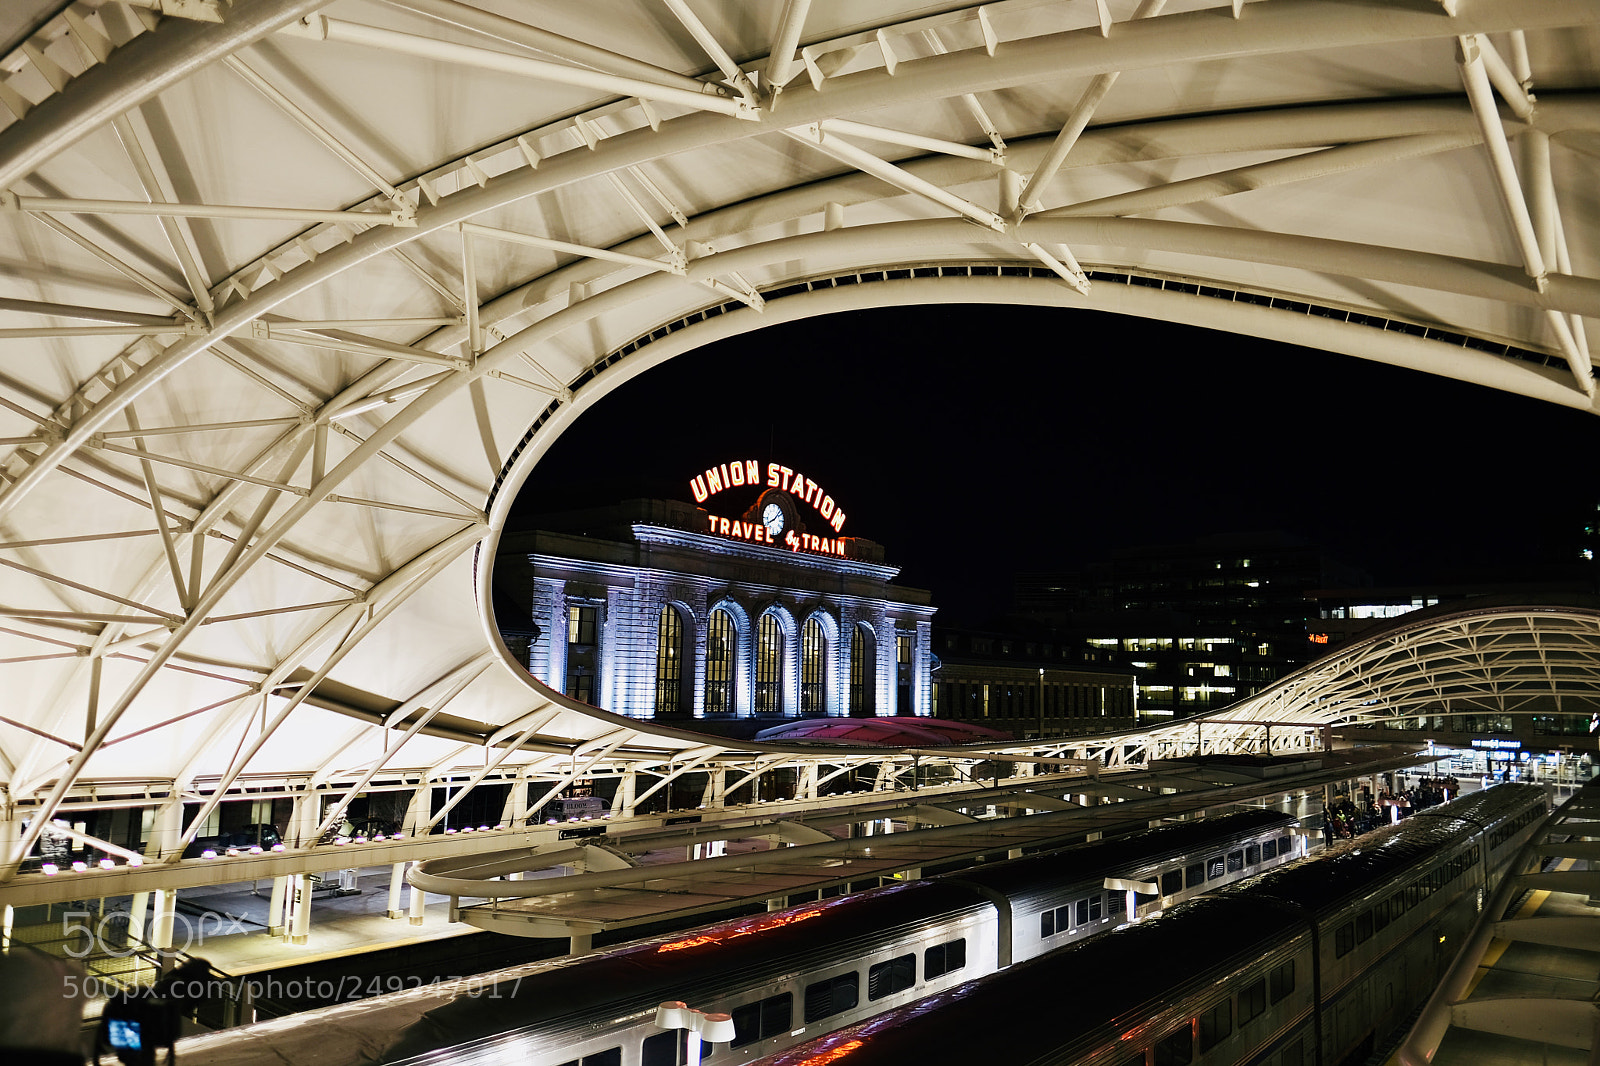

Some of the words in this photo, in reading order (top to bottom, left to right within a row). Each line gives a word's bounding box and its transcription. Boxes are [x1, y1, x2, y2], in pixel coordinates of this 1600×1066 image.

[690, 459, 760, 502] UNION
[767, 462, 846, 533] STATION
[708, 514, 774, 543] TRAVEL
[785, 530, 800, 552] by
[801, 533, 845, 556] TRAIN
